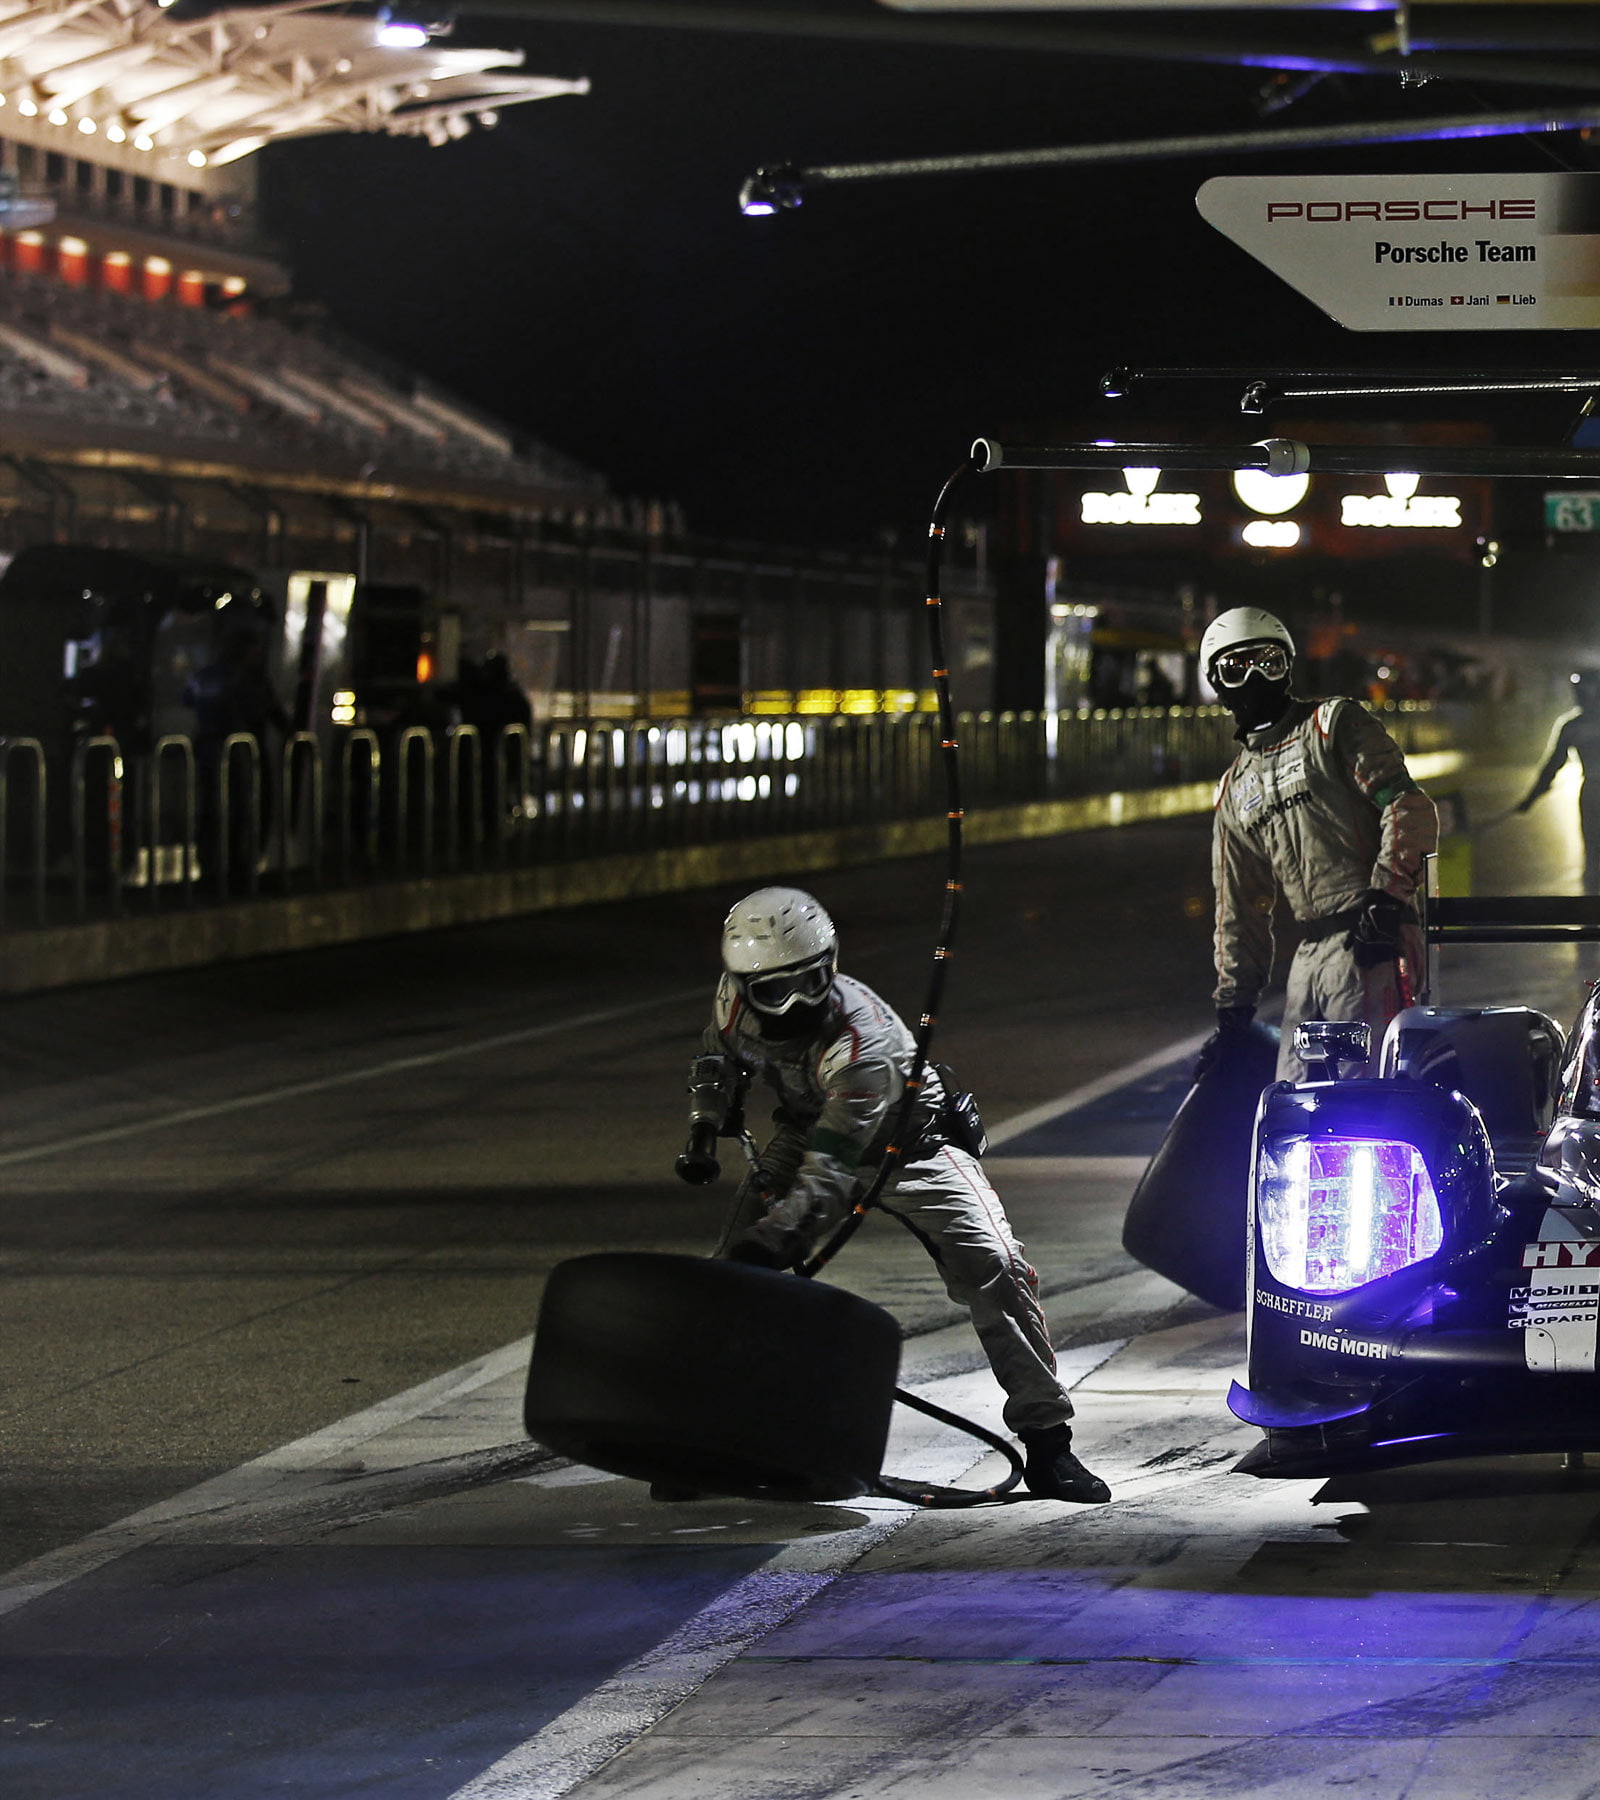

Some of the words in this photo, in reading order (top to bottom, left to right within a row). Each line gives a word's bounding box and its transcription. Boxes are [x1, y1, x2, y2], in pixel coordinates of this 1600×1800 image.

[1267, 199, 1536, 222] PORSCHE
[1375, 241, 1468, 263] Porsche
[1475, 240, 1537, 263] Team
[1405, 296, 1444, 307] Dumas
[1466, 295, 1490, 307] Jani
[1512, 294, 1537, 305] Lieb
[1556, 501, 1593, 531] 63
[1523, 1243, 1600, 1267] HY
[1511, 1285, 1575, 1298] Mobil
[1256, 1288, 1333, 1322] SCHAEFFLER
[1536, 1300, 1597, 1309] MICHELIN
[1509, 1314, 1597, 1328] CHOPARD
[1300, 1329, 1339, 1351] DMG
[1340, 1338, 1388, 1360] MORI
